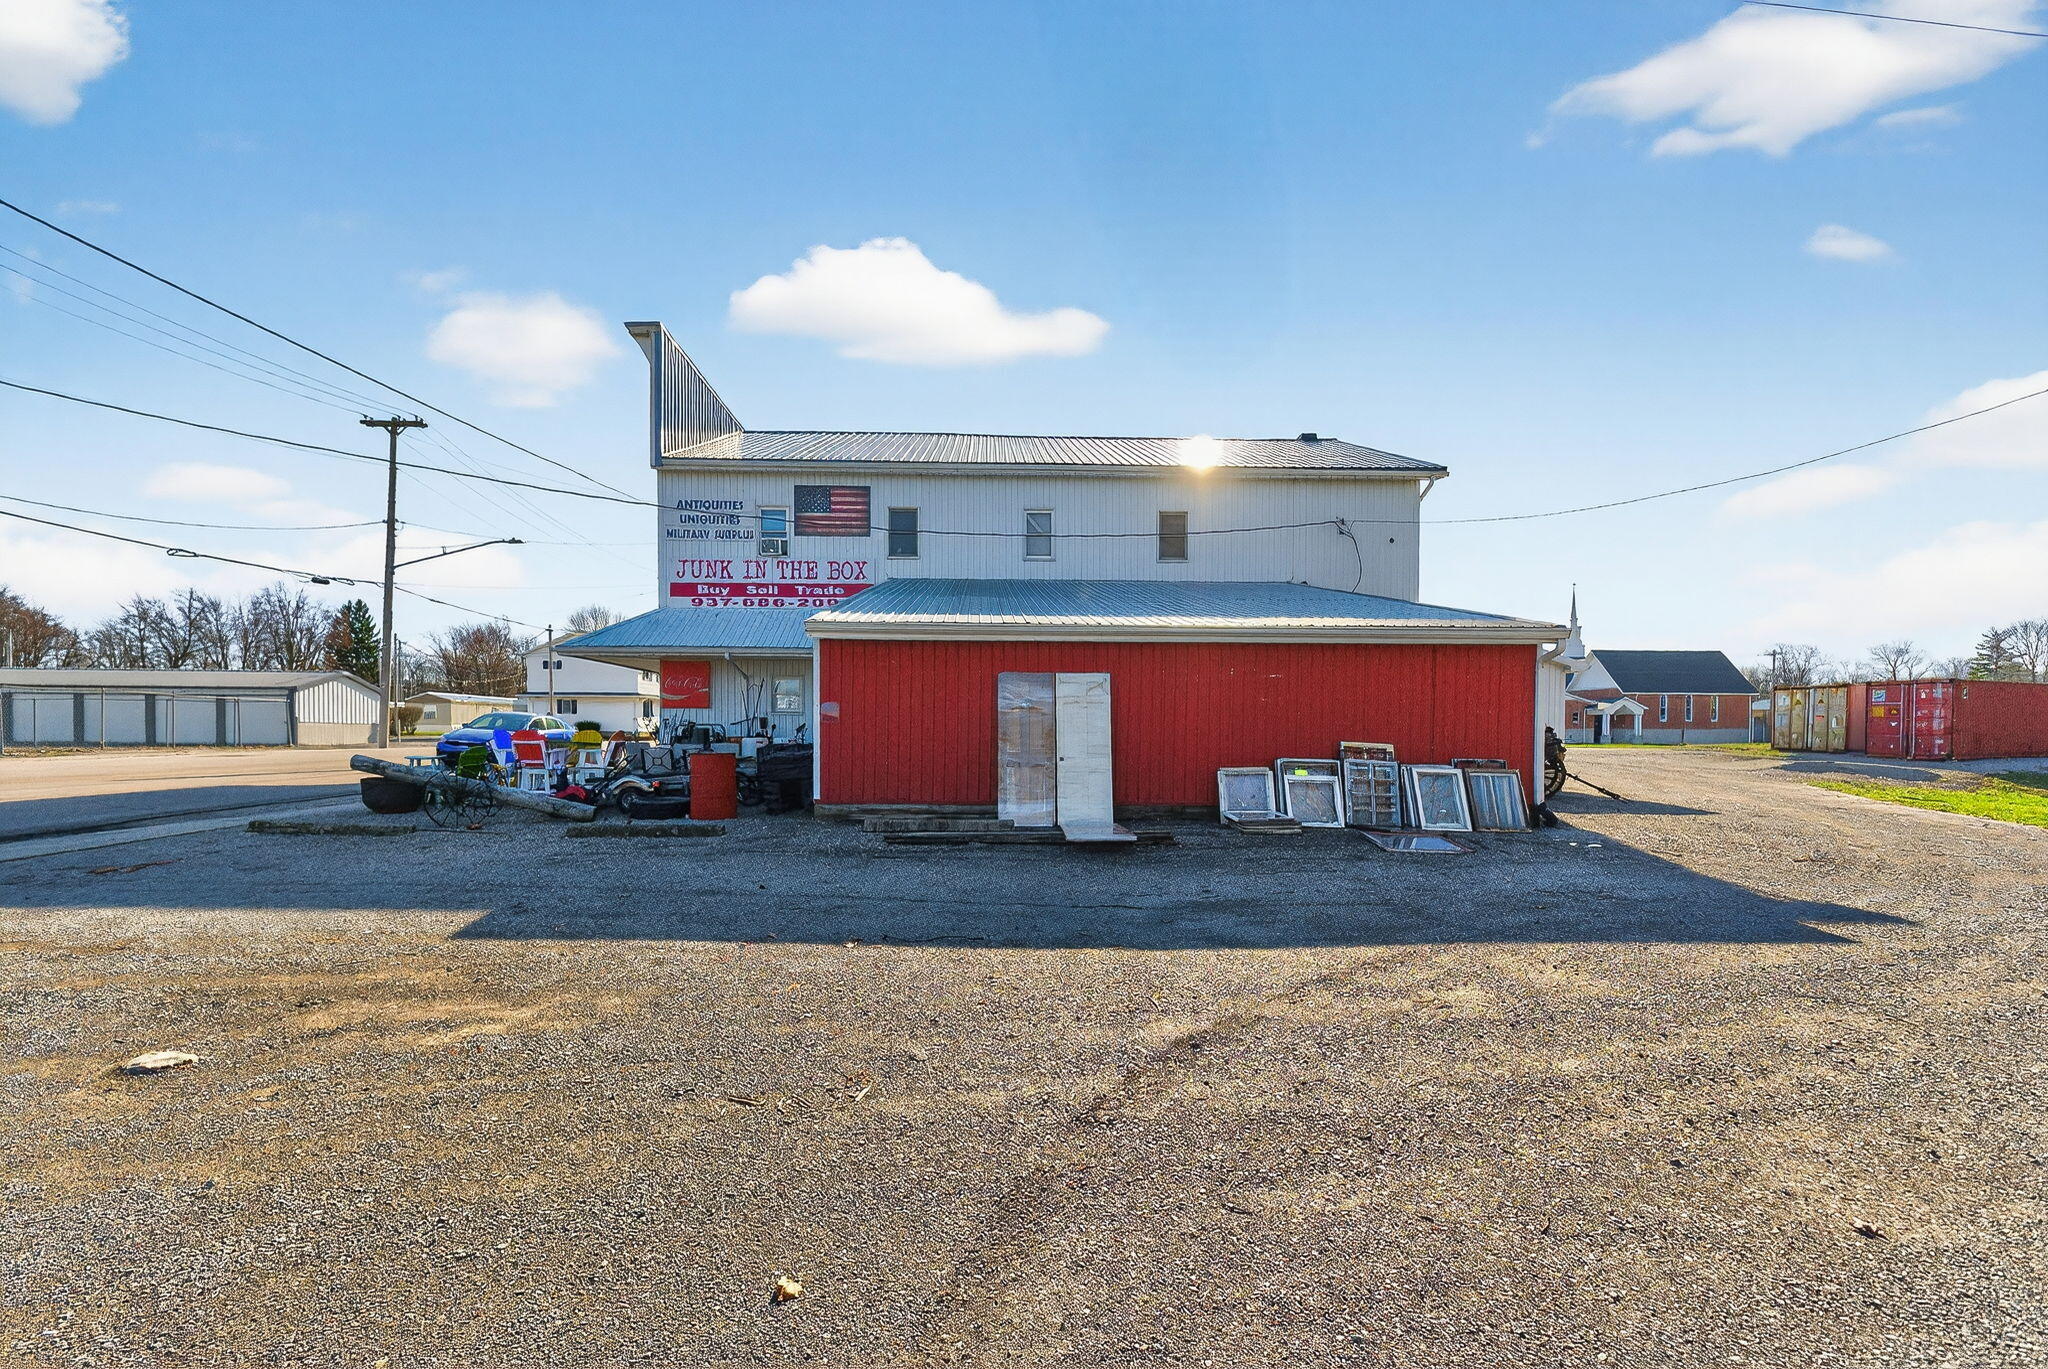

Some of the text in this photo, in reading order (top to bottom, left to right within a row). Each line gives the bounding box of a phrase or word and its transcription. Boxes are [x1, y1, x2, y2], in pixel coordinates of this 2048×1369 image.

[676, 499, 744, 510] ANTIQUITIES
[680, 514, 741, 525] UNIQUITIES
[666, 528, 754, 540] MILITARY SURPLUS
[676, 559, 868, 580] JUNK IN THE BOX
[697, 584, 845, 595] Buy Sell Trade
